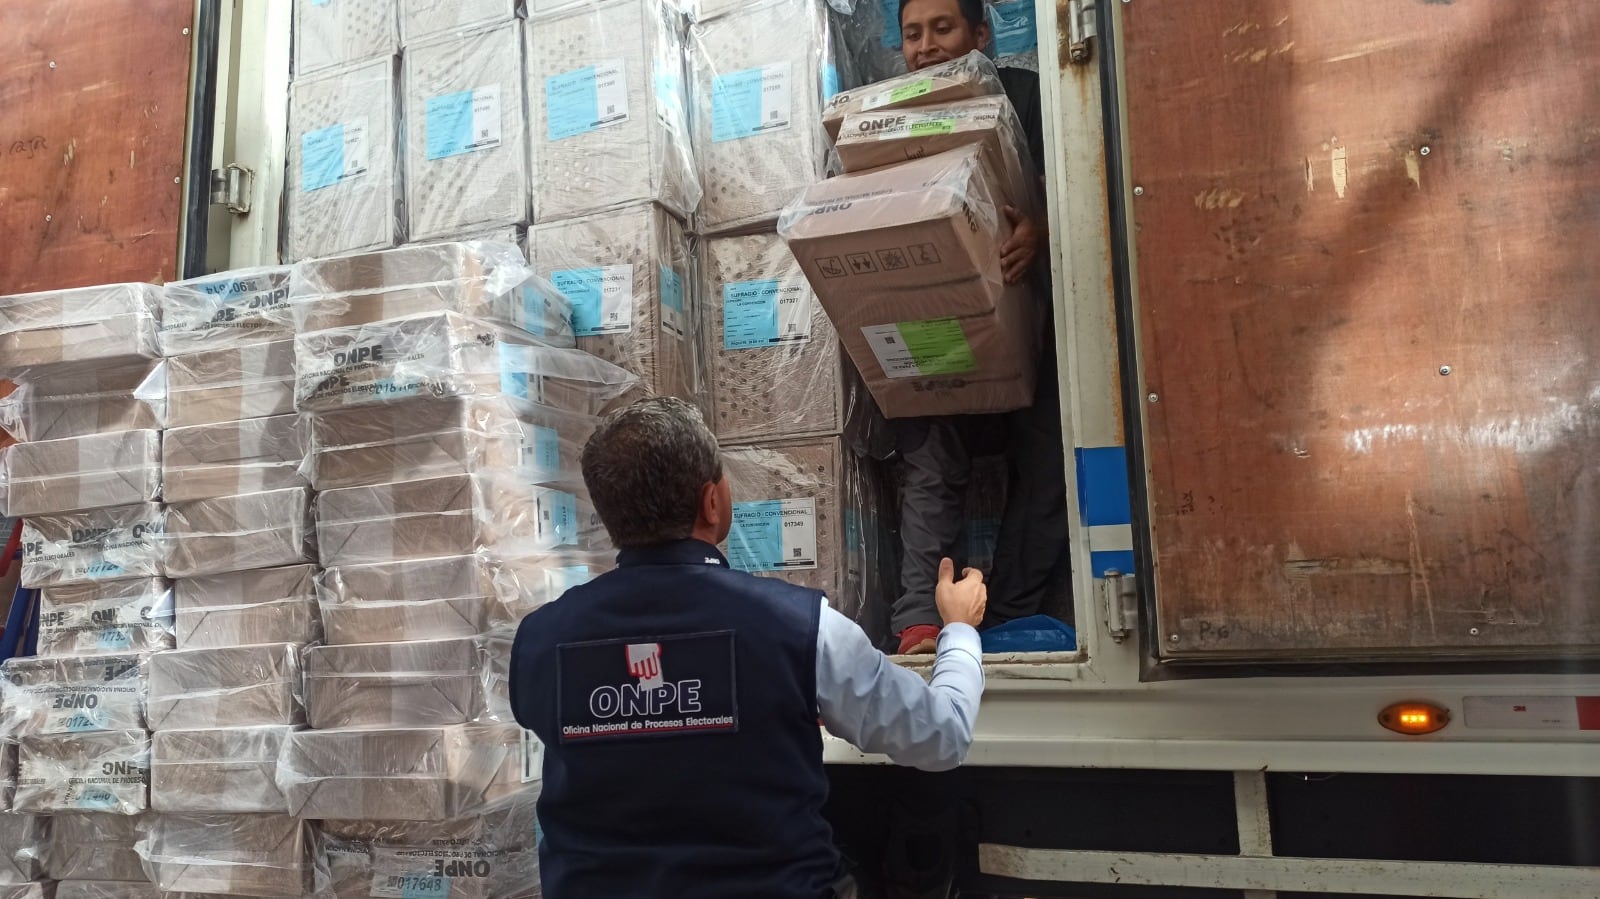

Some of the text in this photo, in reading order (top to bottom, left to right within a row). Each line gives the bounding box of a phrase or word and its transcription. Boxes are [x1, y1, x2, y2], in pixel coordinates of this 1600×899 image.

[858, 115, 907, 132] ONPE
[730, 290, 758, 299] SUFRAGIO
[333, 345, 384, 367] ONPE
[765, 509, 808, 518] CONVENCIONAL
[53, 693, 98, 709] ONPE
[590, 679, 702, 718] ONPE
[563, 715, 734, 736] Oficina Nacional de Procesos Electorales
[433, 859, 491, 878] ONPE
[397, 876, 442, 892] 017648
